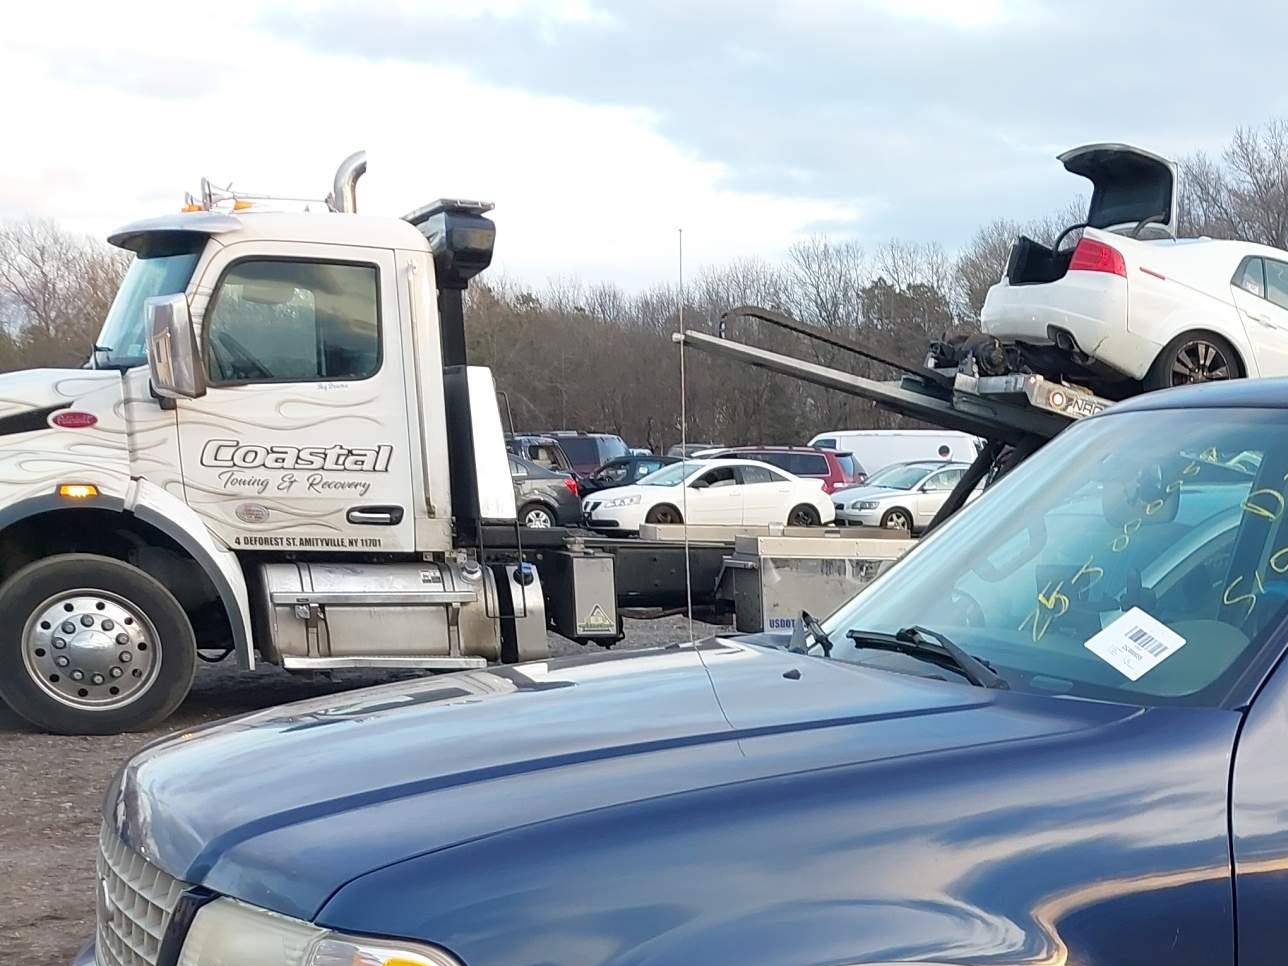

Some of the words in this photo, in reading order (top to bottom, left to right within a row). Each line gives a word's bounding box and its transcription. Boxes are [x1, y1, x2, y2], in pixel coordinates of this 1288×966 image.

[200, 439, 394, 473] Coastal
[218, 470, 271, 494] Towing
[277, 473, 298, 494] &
[307, 473, 372, 497] Recovery
[235, 537, 241, 546] 4
[243, 536, 284, 547] DEFOREST
[286, 537, 298, 547] ST.
[300, 537, 347, 548] AMITYVILLE,
[348, 538, 358, 547] NY
[360, 538, 382, 547] 11701
[769, 619, 795, 629] USDOT
